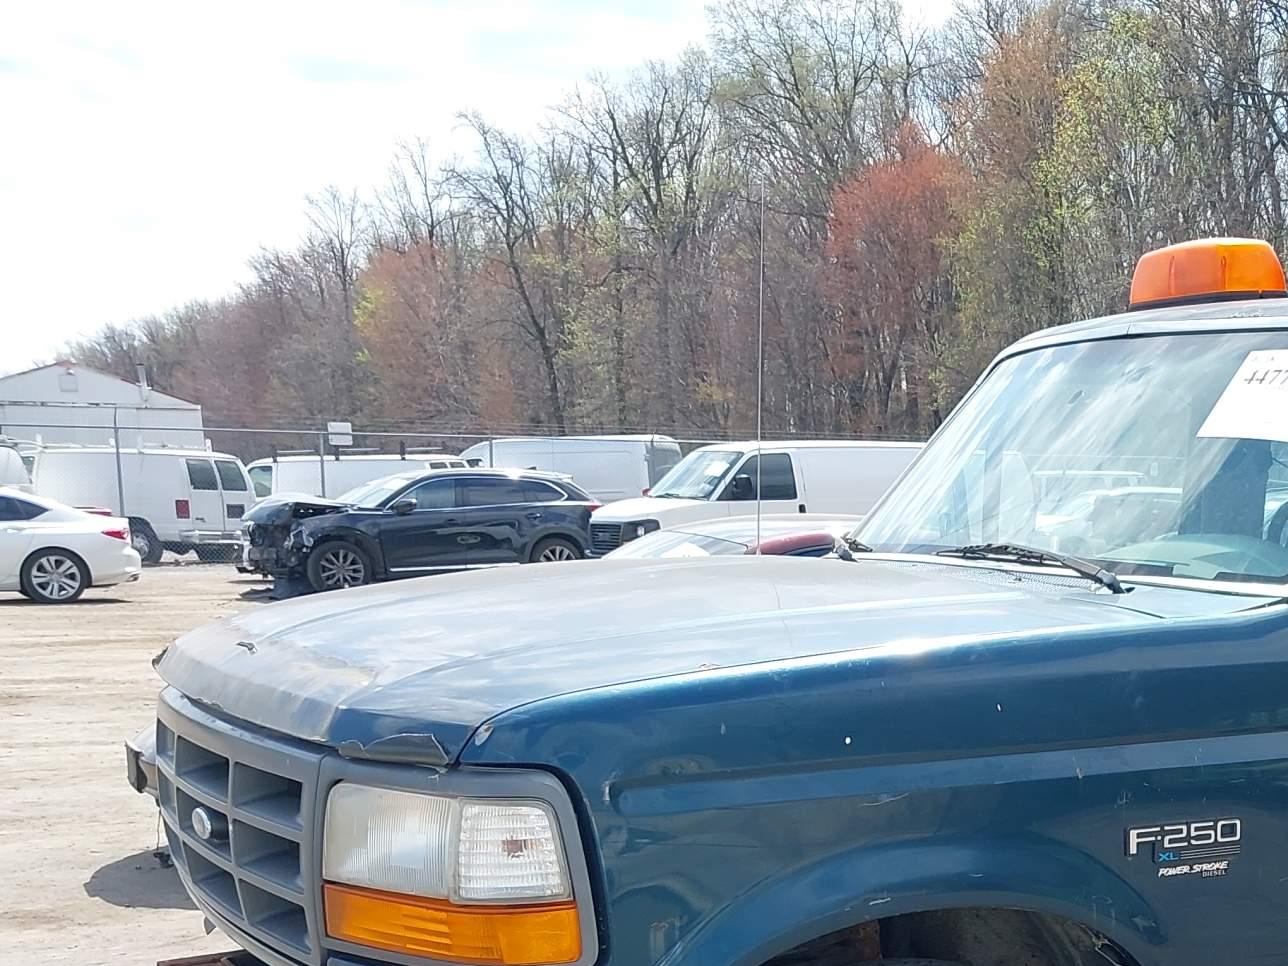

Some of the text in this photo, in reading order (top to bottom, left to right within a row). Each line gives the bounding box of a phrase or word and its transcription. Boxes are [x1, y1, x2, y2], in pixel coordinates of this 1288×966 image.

[1158, 851, 1179, 862] XL
[1158, 860, 1229, 878] POWER STROKE
[1202, 869, 1227, 878] DIESEL
